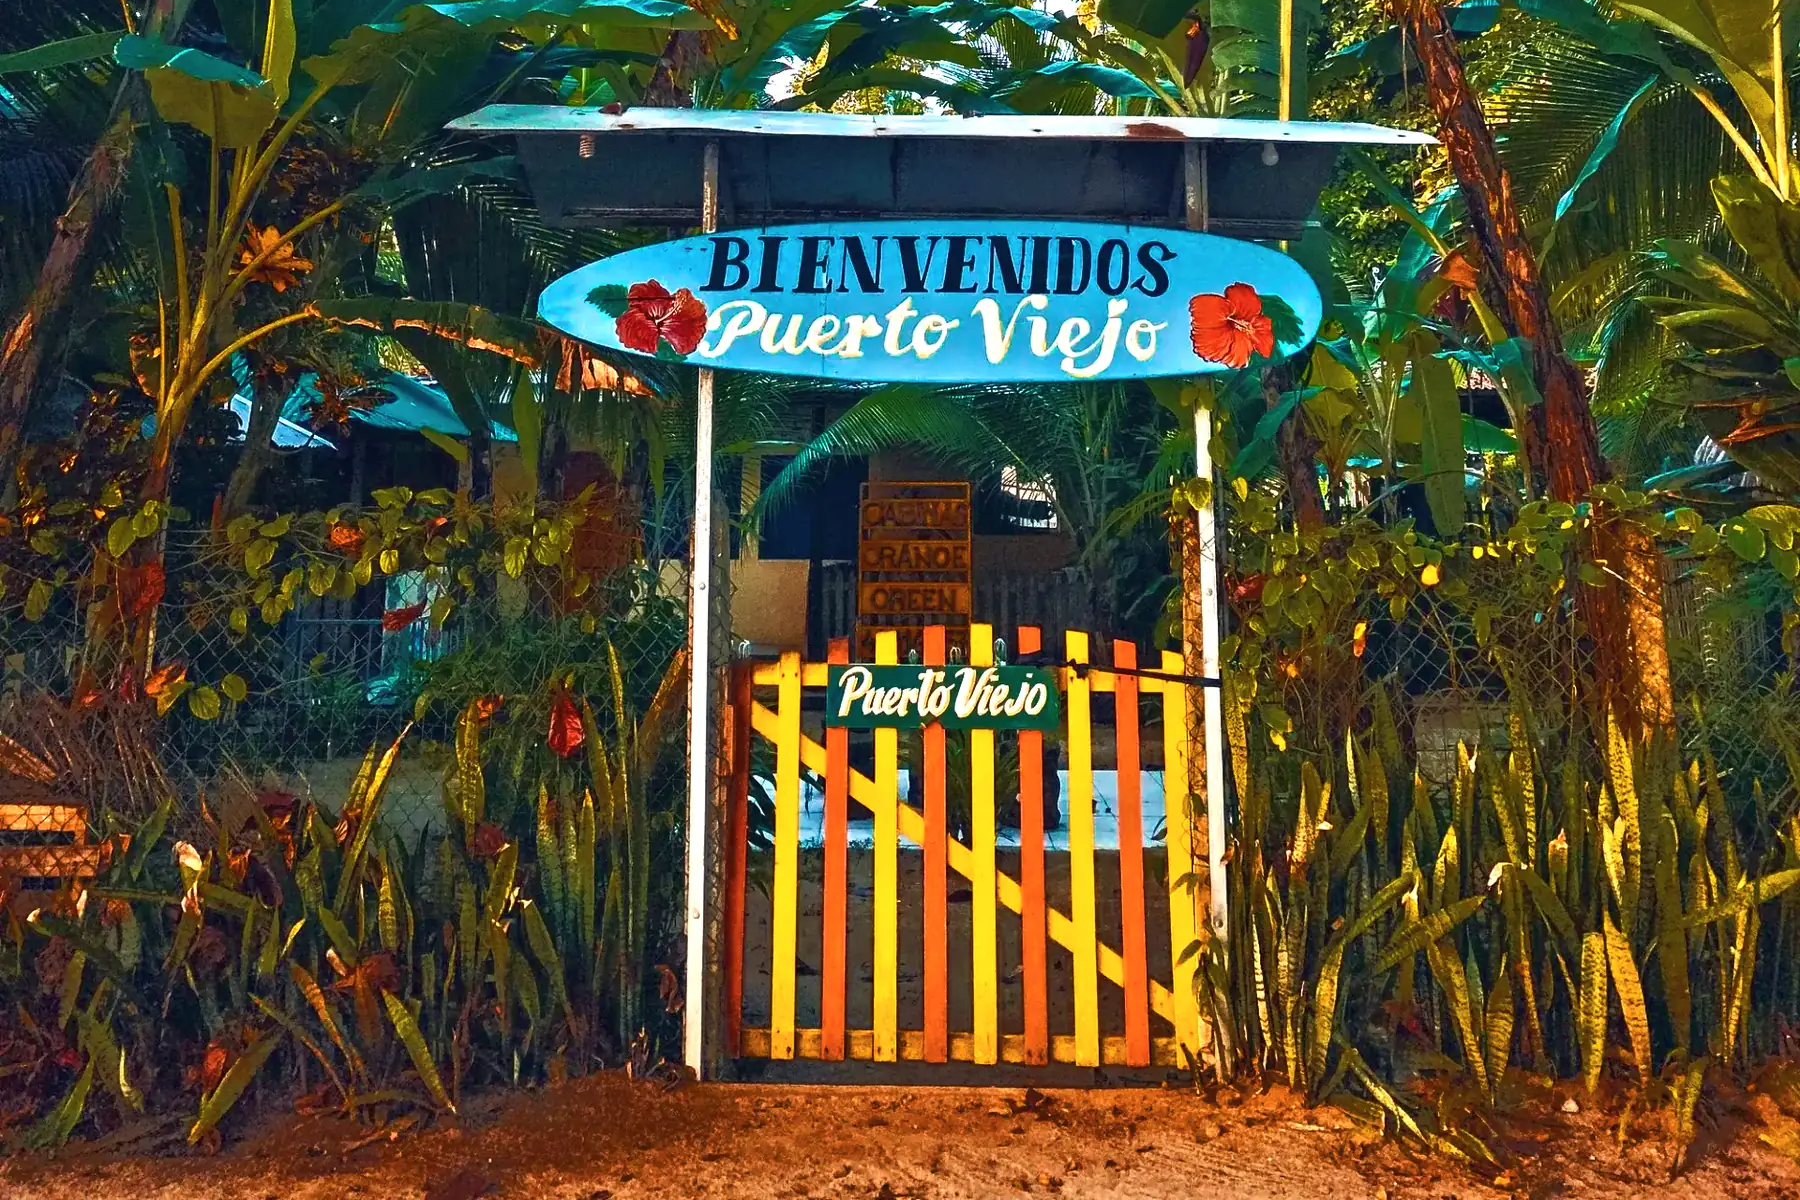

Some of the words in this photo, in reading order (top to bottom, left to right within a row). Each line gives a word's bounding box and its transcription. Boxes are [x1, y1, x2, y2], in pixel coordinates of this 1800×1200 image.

[700, 235, 1177, 297] BIENVENIDOS
[700, 297, 959, 358] Puerto
[971, 294, 1167, 377] Viejo
[838, 667, 955, 717] Puerto
[955, 667, 1047, 717] Viejo
